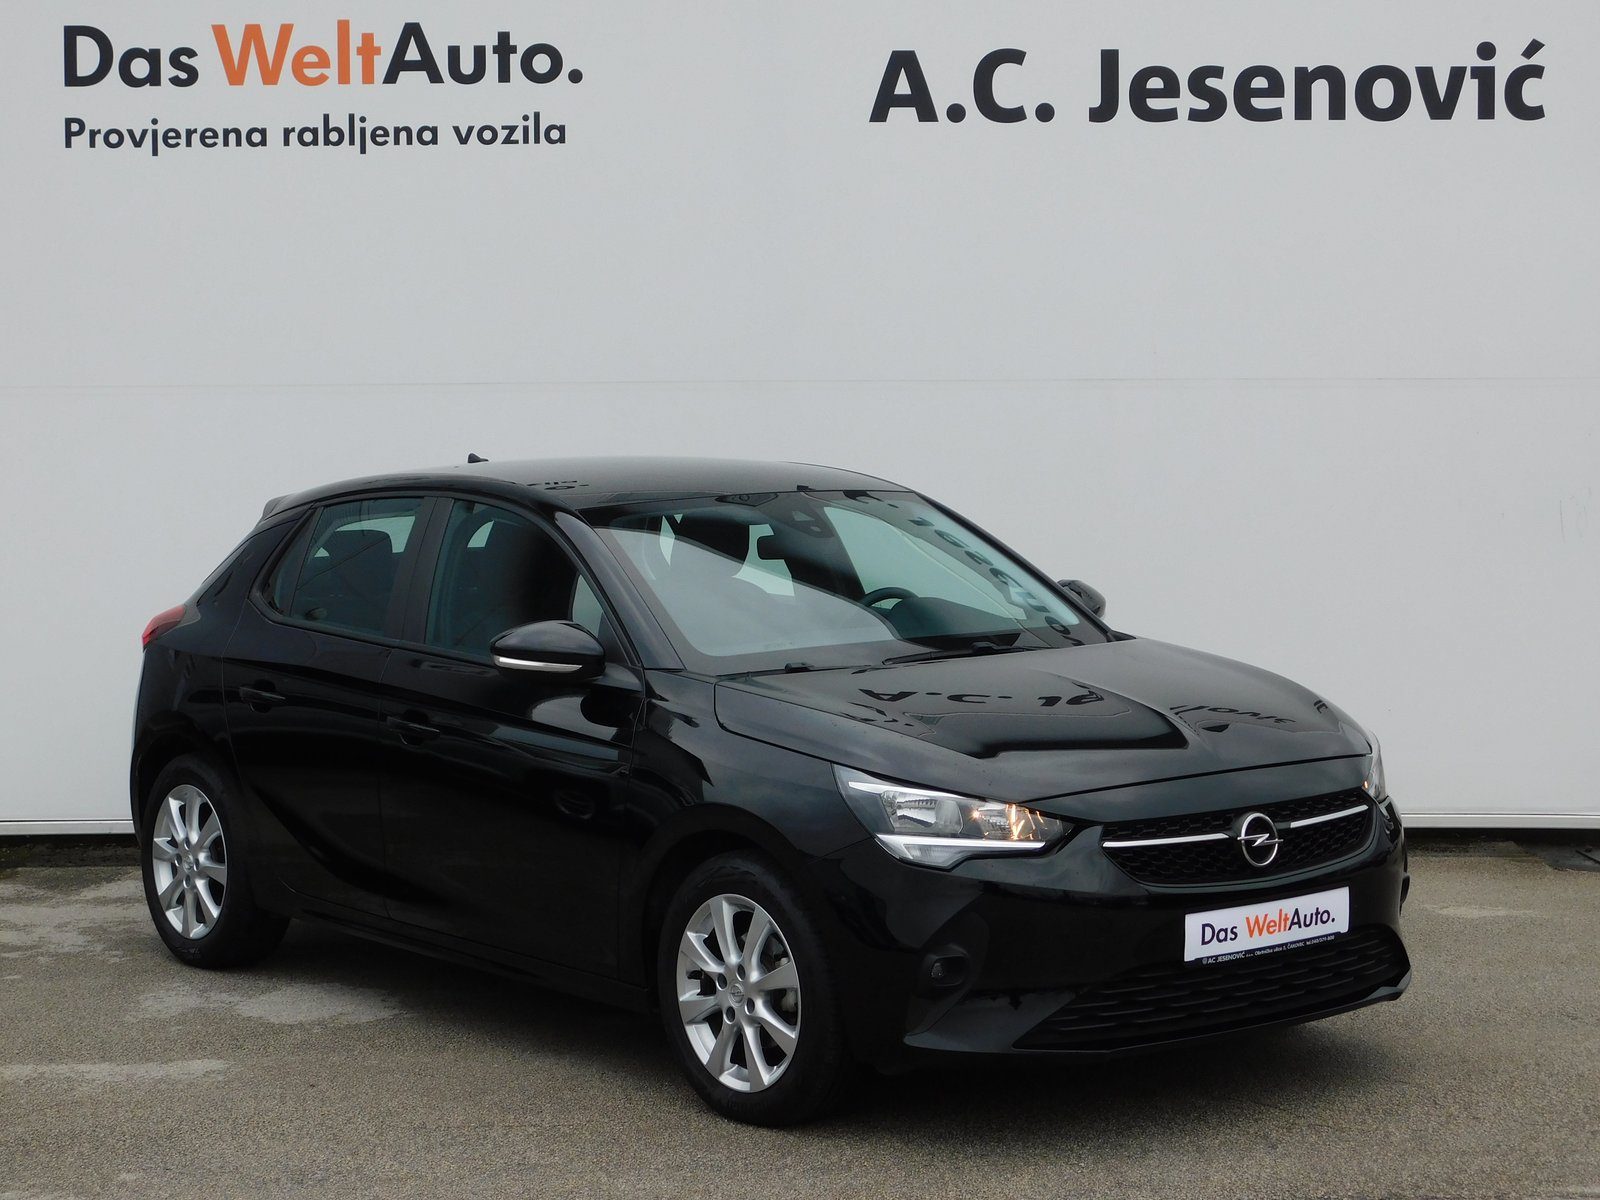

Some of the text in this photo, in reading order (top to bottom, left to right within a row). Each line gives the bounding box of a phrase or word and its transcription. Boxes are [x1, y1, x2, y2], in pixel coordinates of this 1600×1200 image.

[64, 20, 583, 88] Das WeltAuto.
[869, 39, 1545, 123] A.C. Jesenović
[65, 112, 565, 157] Provjerena rabljena vozila
[1201, 908, 1336, 946] Das WeltAuto.
[1217, 952, 1245, 963] JESENOVIĆ
